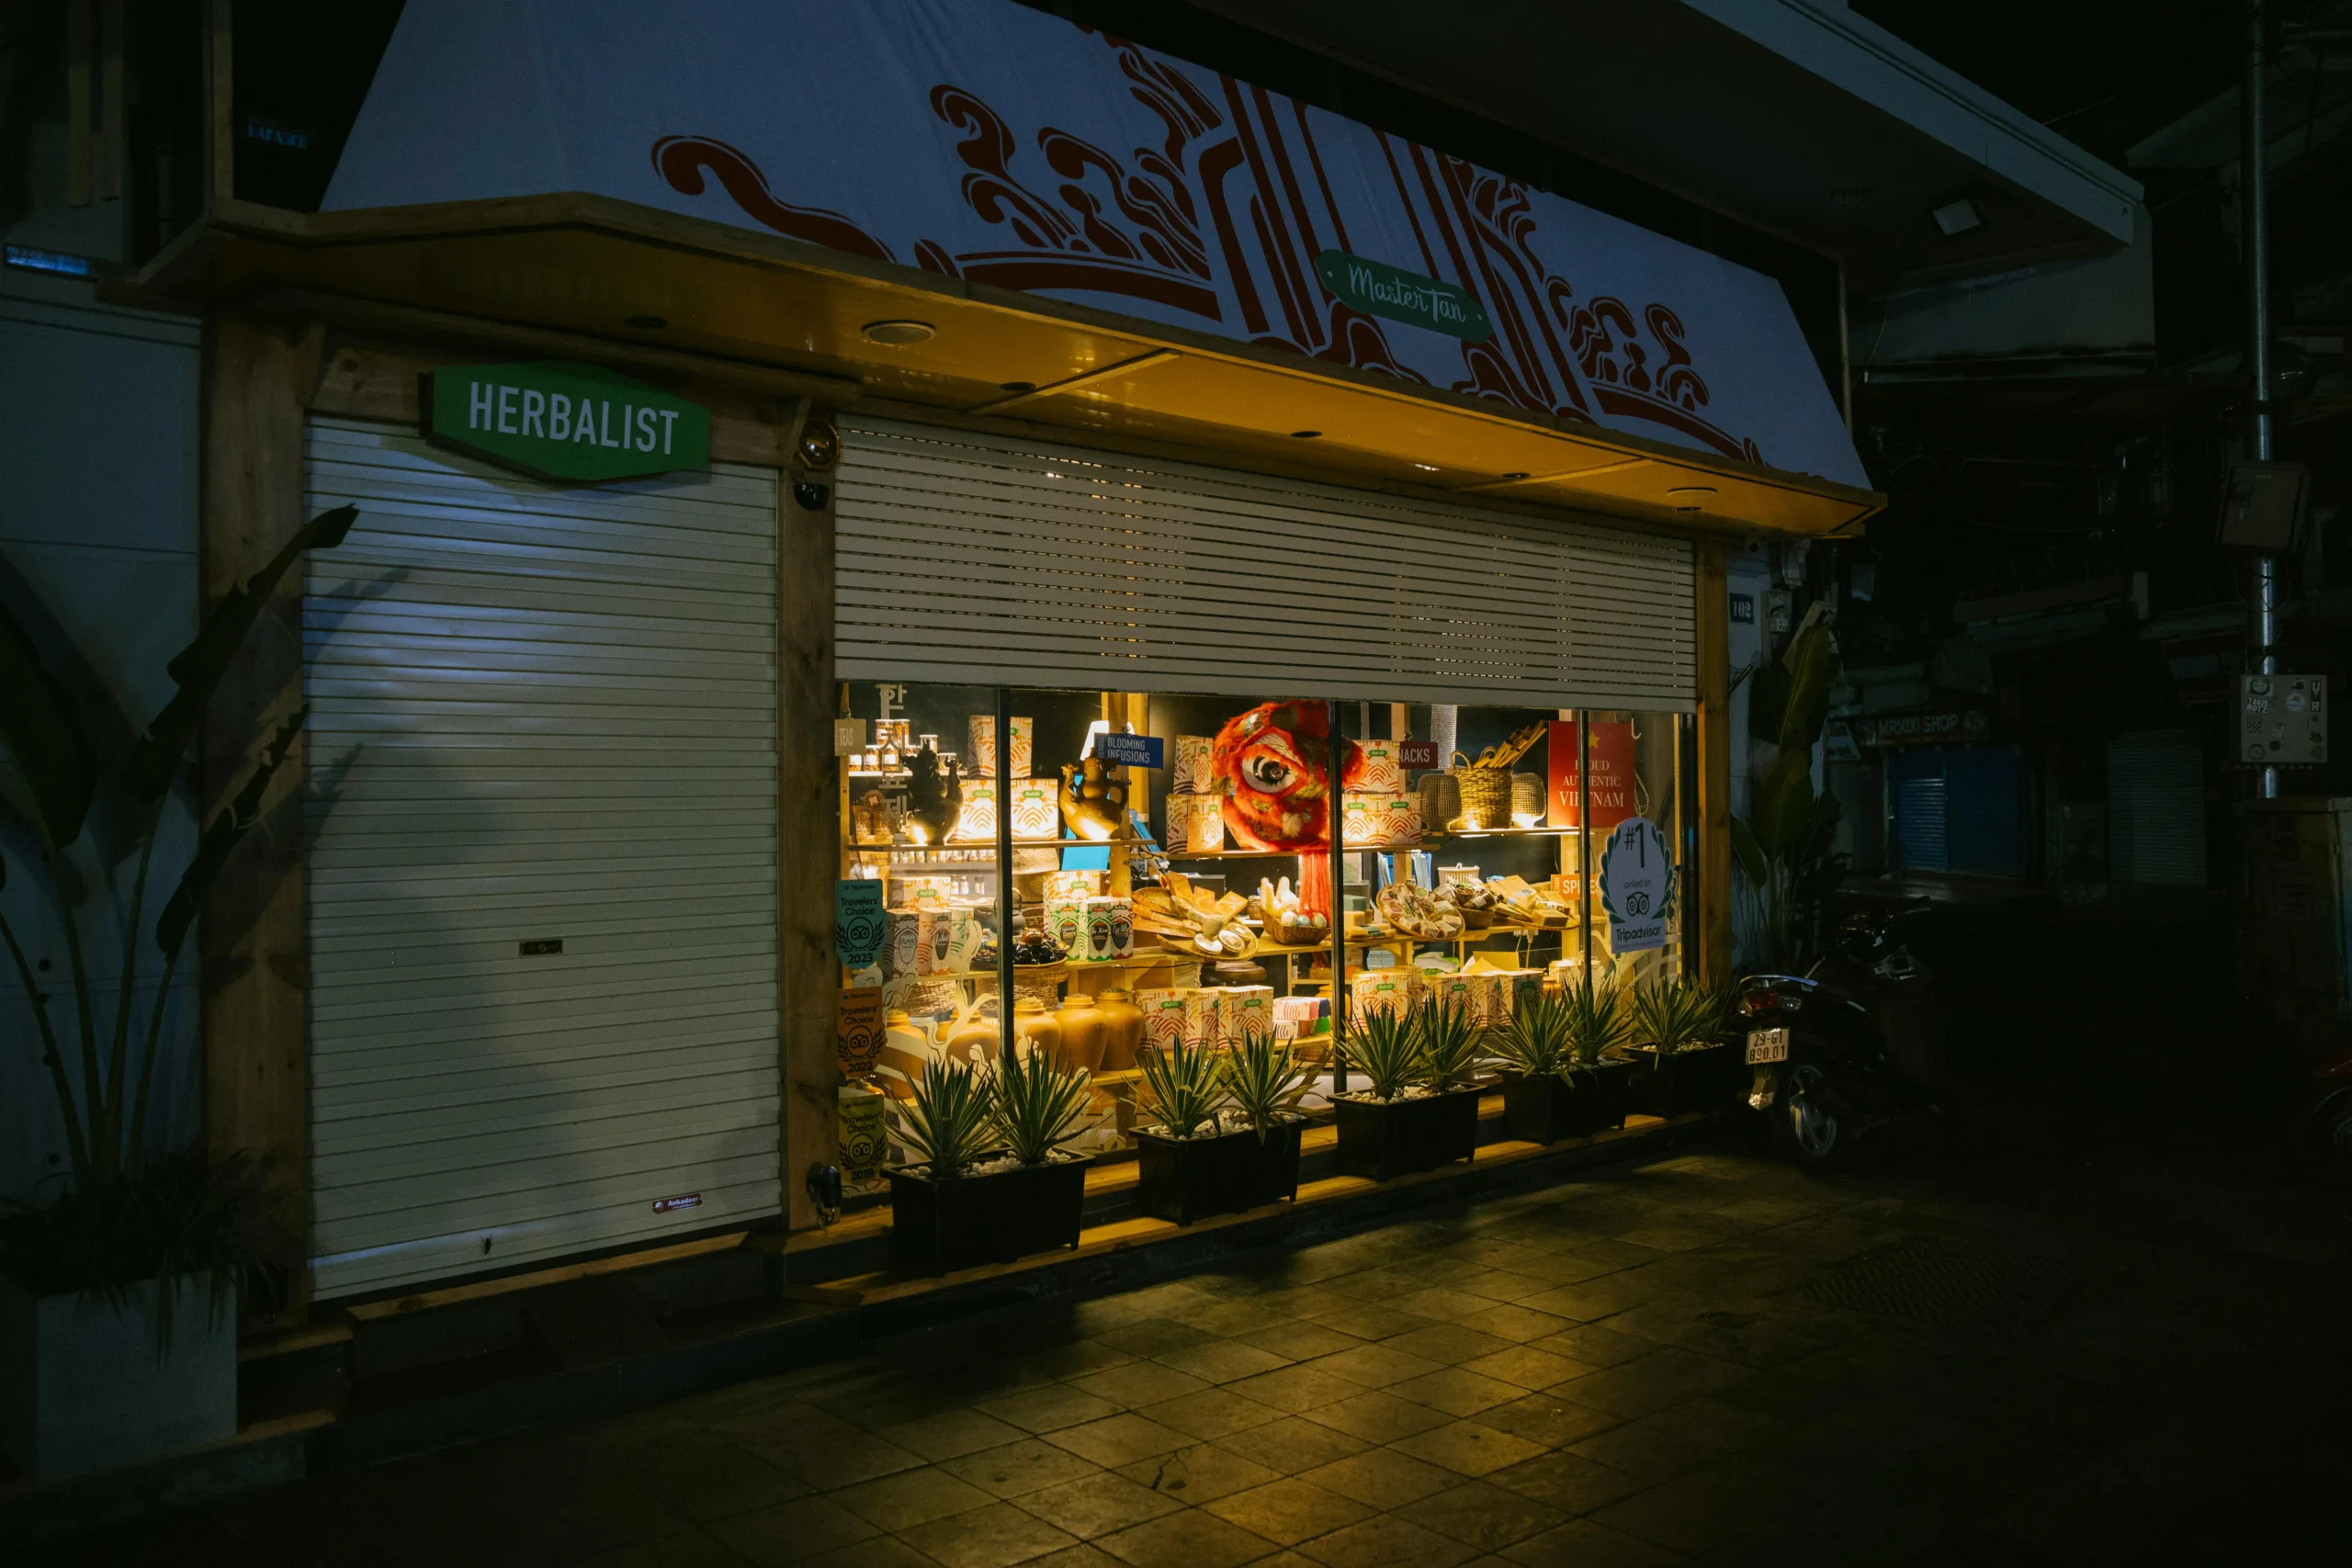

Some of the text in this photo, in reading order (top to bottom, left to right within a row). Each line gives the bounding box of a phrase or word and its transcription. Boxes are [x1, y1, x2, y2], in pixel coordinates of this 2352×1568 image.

[1348, 263, 1466, 323] Master Tan
[469, 381, 679, 456] HERBALIST
[1732, 601, 1752, 618] 102
[1923, 713, 1959, 734] SHOP
[839, 727, 854, 747] TEAS
[1107, 737, 1146, 750] BLOOMING
[1107, 748, 1150, 763] INFUSIONS
[1399, 748, 1430, 762] NACKS
[1575, 759, 1610, 771] OUD
[1558, 790, 1624, 807] VIENAM
[1623, 822, 1645, 869] #1
[1623, 878, 1652, 889] ranked on
[841, 896, 880, 907] Travelers'
[845, 907, 875, 917] Choice
[1615, 923, 1662, 942] Tripadvisor
[847, 953, 874, 964] 2023
[840, 1003, 879, 1016] Travelers'
[844, 1015, 875, 1026] Choice
[1753, 1030, 1783, 1047] 29-G1
[847, 1060, 873, 1074] 2022
[846, 1122, 876, 1134] Choice
[850, 1168, 875, 1182] 2019
[667, 1197, 699, 1207] Ankadoor
